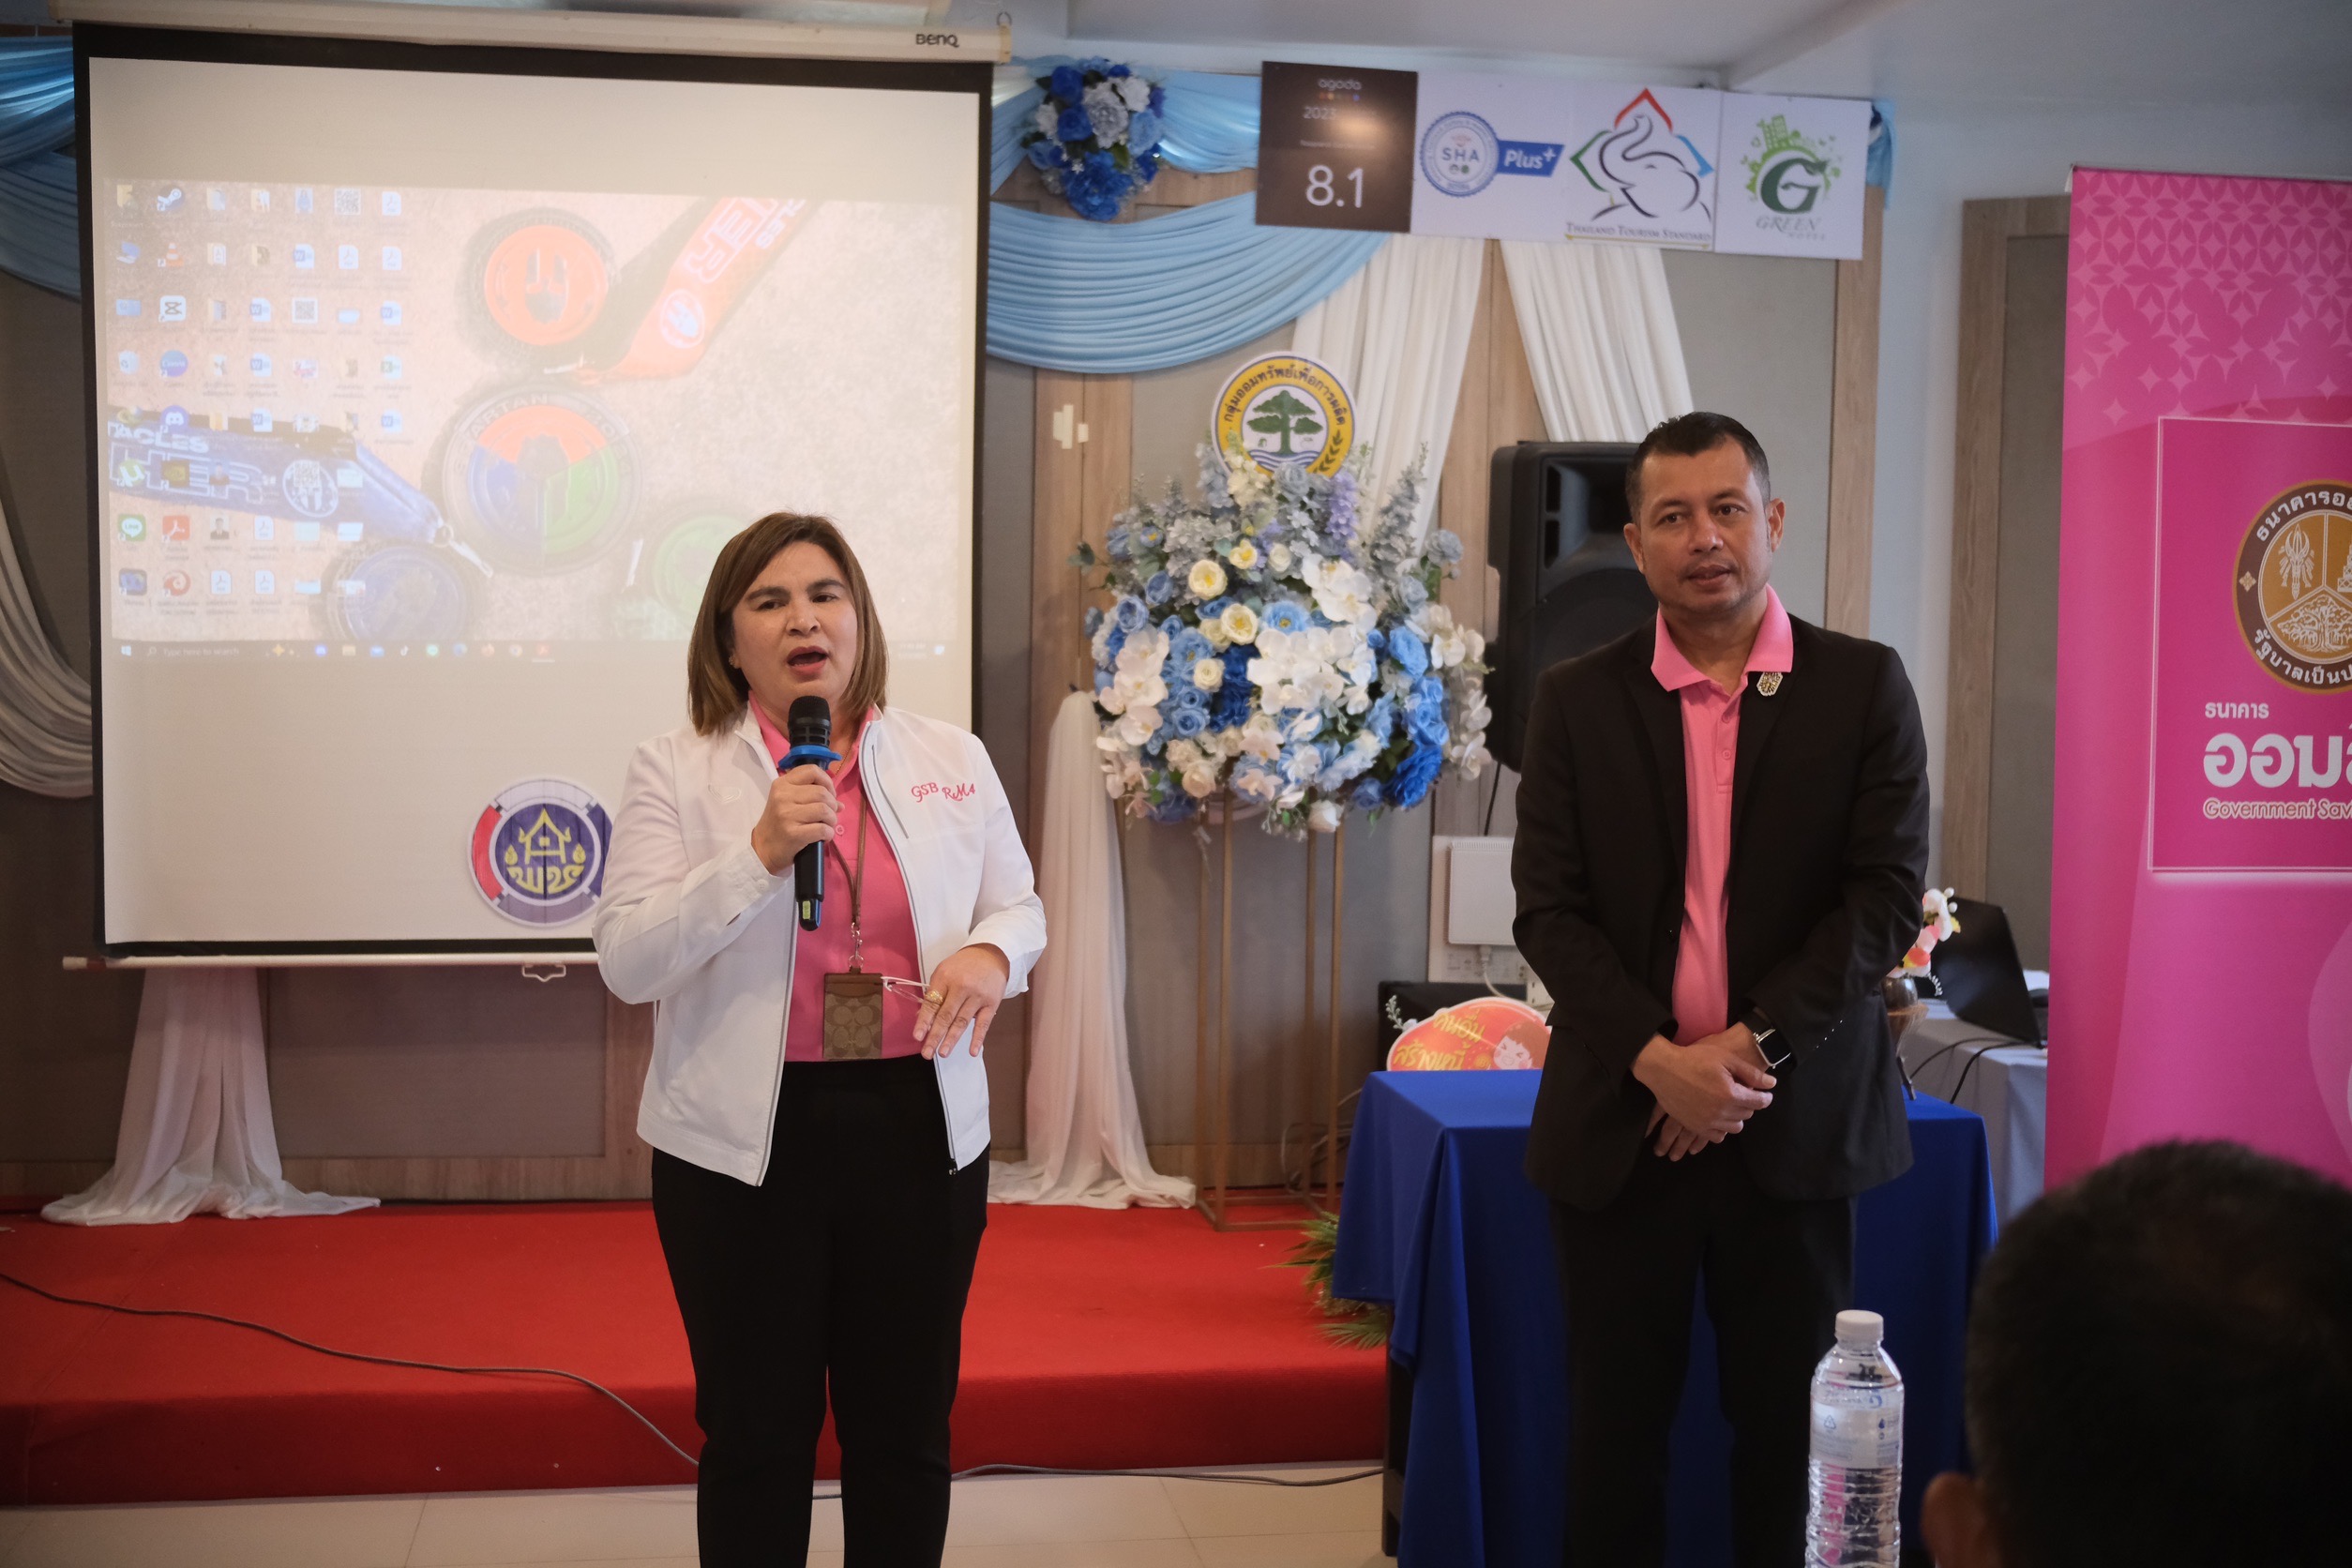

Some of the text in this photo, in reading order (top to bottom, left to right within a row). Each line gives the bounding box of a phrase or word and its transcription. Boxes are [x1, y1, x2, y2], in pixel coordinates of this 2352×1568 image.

[915, 34, 959, 48] BenQ
[1318, 79, 1362, 91] agoda
[1442, 147, 1480, 161] SHA
[1305, 164, 1364, 208] 8.1
[2205, 701, 2269, 719] ธนาคาร
[2203, 724, 2352, 789] ออม
[911, 782, 939, 803] GSB
[2203, 797, 2352, 820] Government Sav
